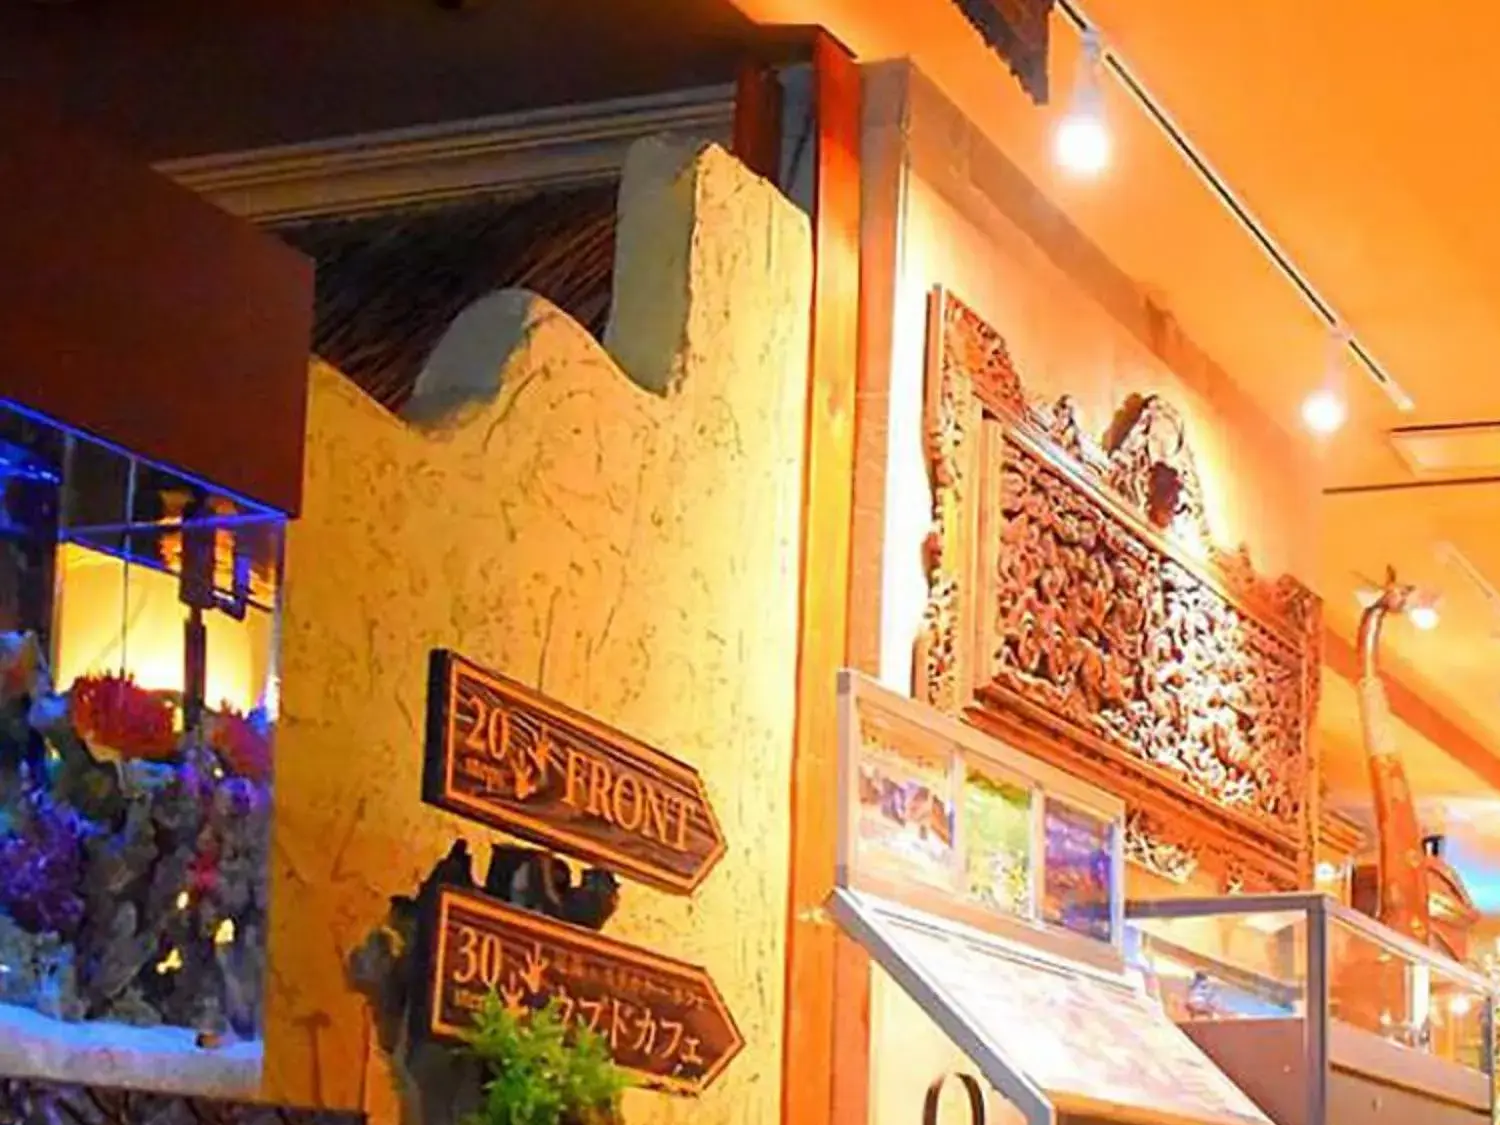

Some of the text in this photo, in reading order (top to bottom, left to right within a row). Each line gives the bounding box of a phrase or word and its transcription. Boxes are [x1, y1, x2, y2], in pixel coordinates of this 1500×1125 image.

[464, 696, 511, 760] 20
[562, 745, 698, 852] FRONT
[452, 926, 501, 989] 30
